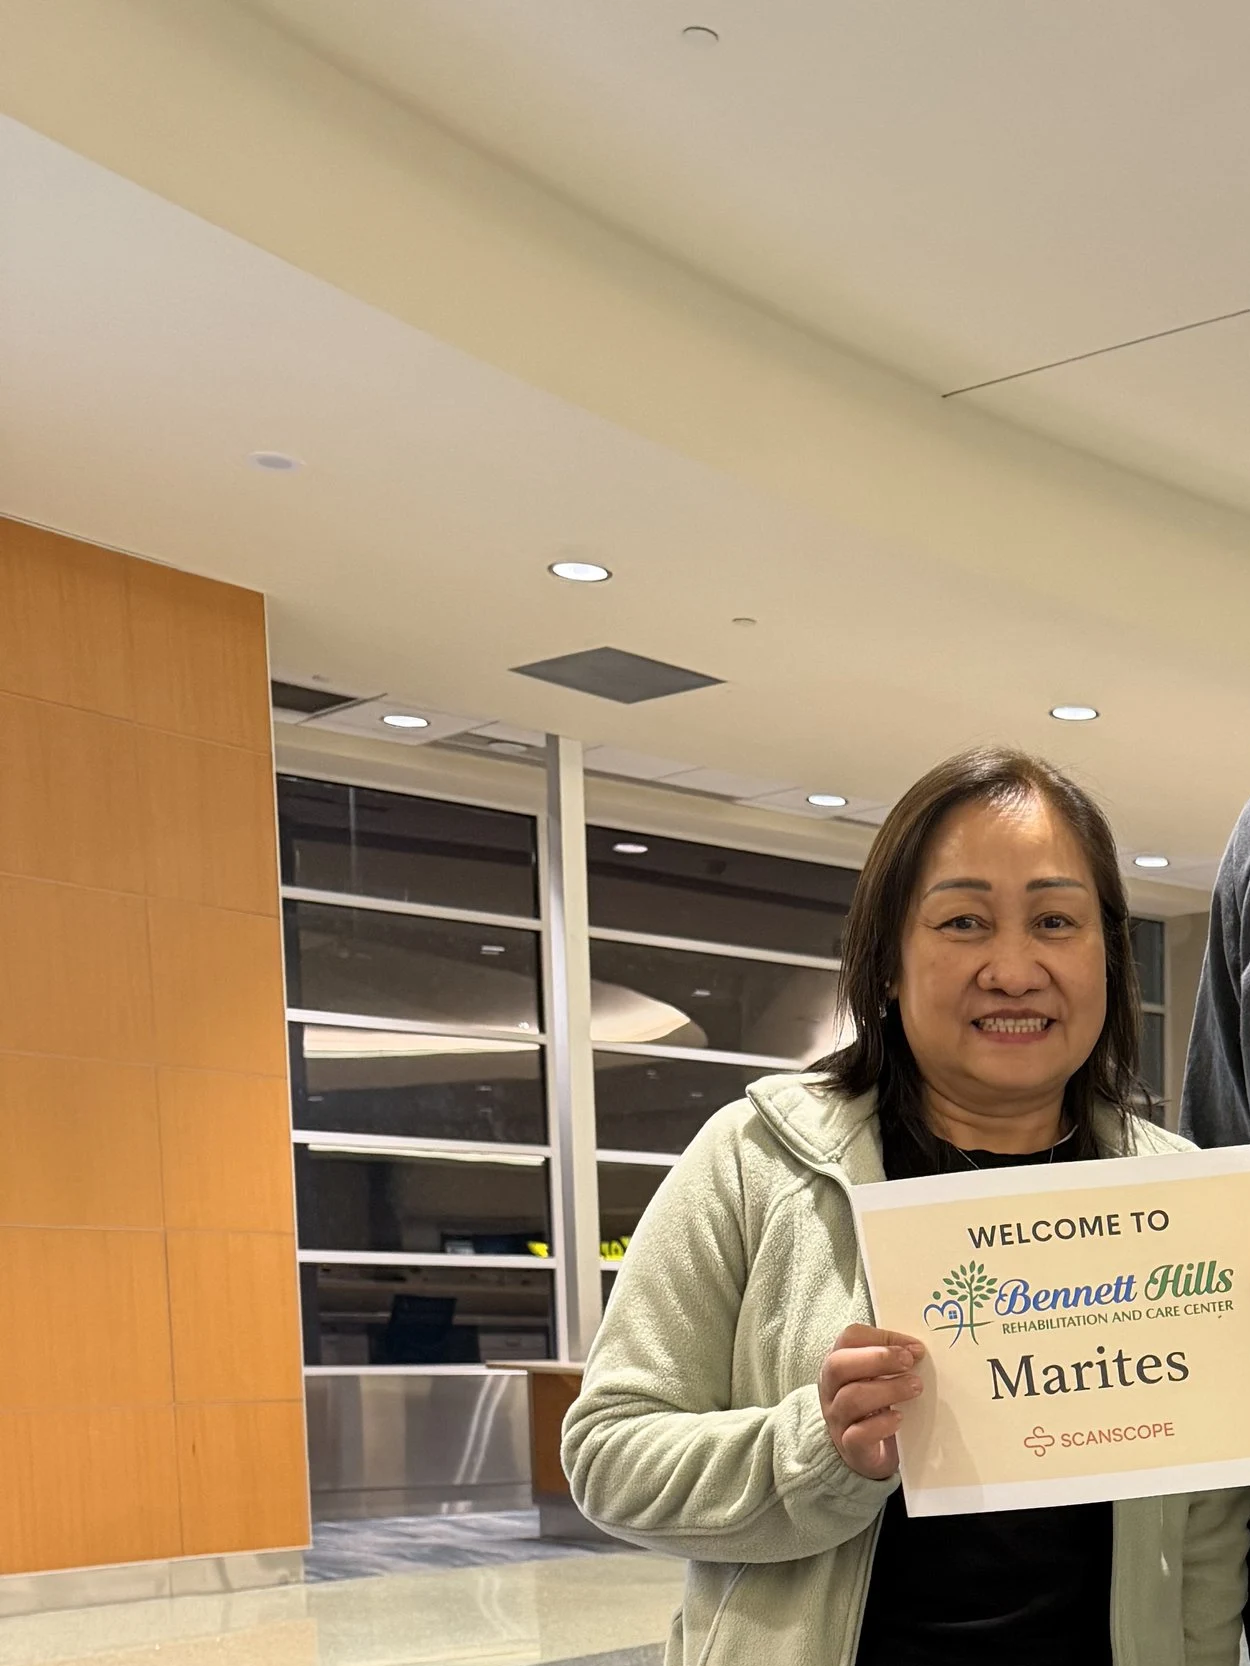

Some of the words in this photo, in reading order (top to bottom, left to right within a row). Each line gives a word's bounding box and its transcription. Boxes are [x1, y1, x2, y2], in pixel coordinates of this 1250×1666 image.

[967, 1213, 1122, 1249] WELCOME
[1130, 1209, 1170, 1233] TO
[994, 1275, 1137, 1316] Bennett
[1144, 1260, 1234, 1301] Hills
[1001, 1313, 1109, 1335] REHABILITATION
[1112, 1310, 1142, 1323] AND
[1145, 1305, 1181, 1320] CARE
[1183, 1300, 1234, 1315] CENTER
[987, 1346, 1190, 1401] Marites
[1060, 1422, 1176, 1448] SCANSCOPE
